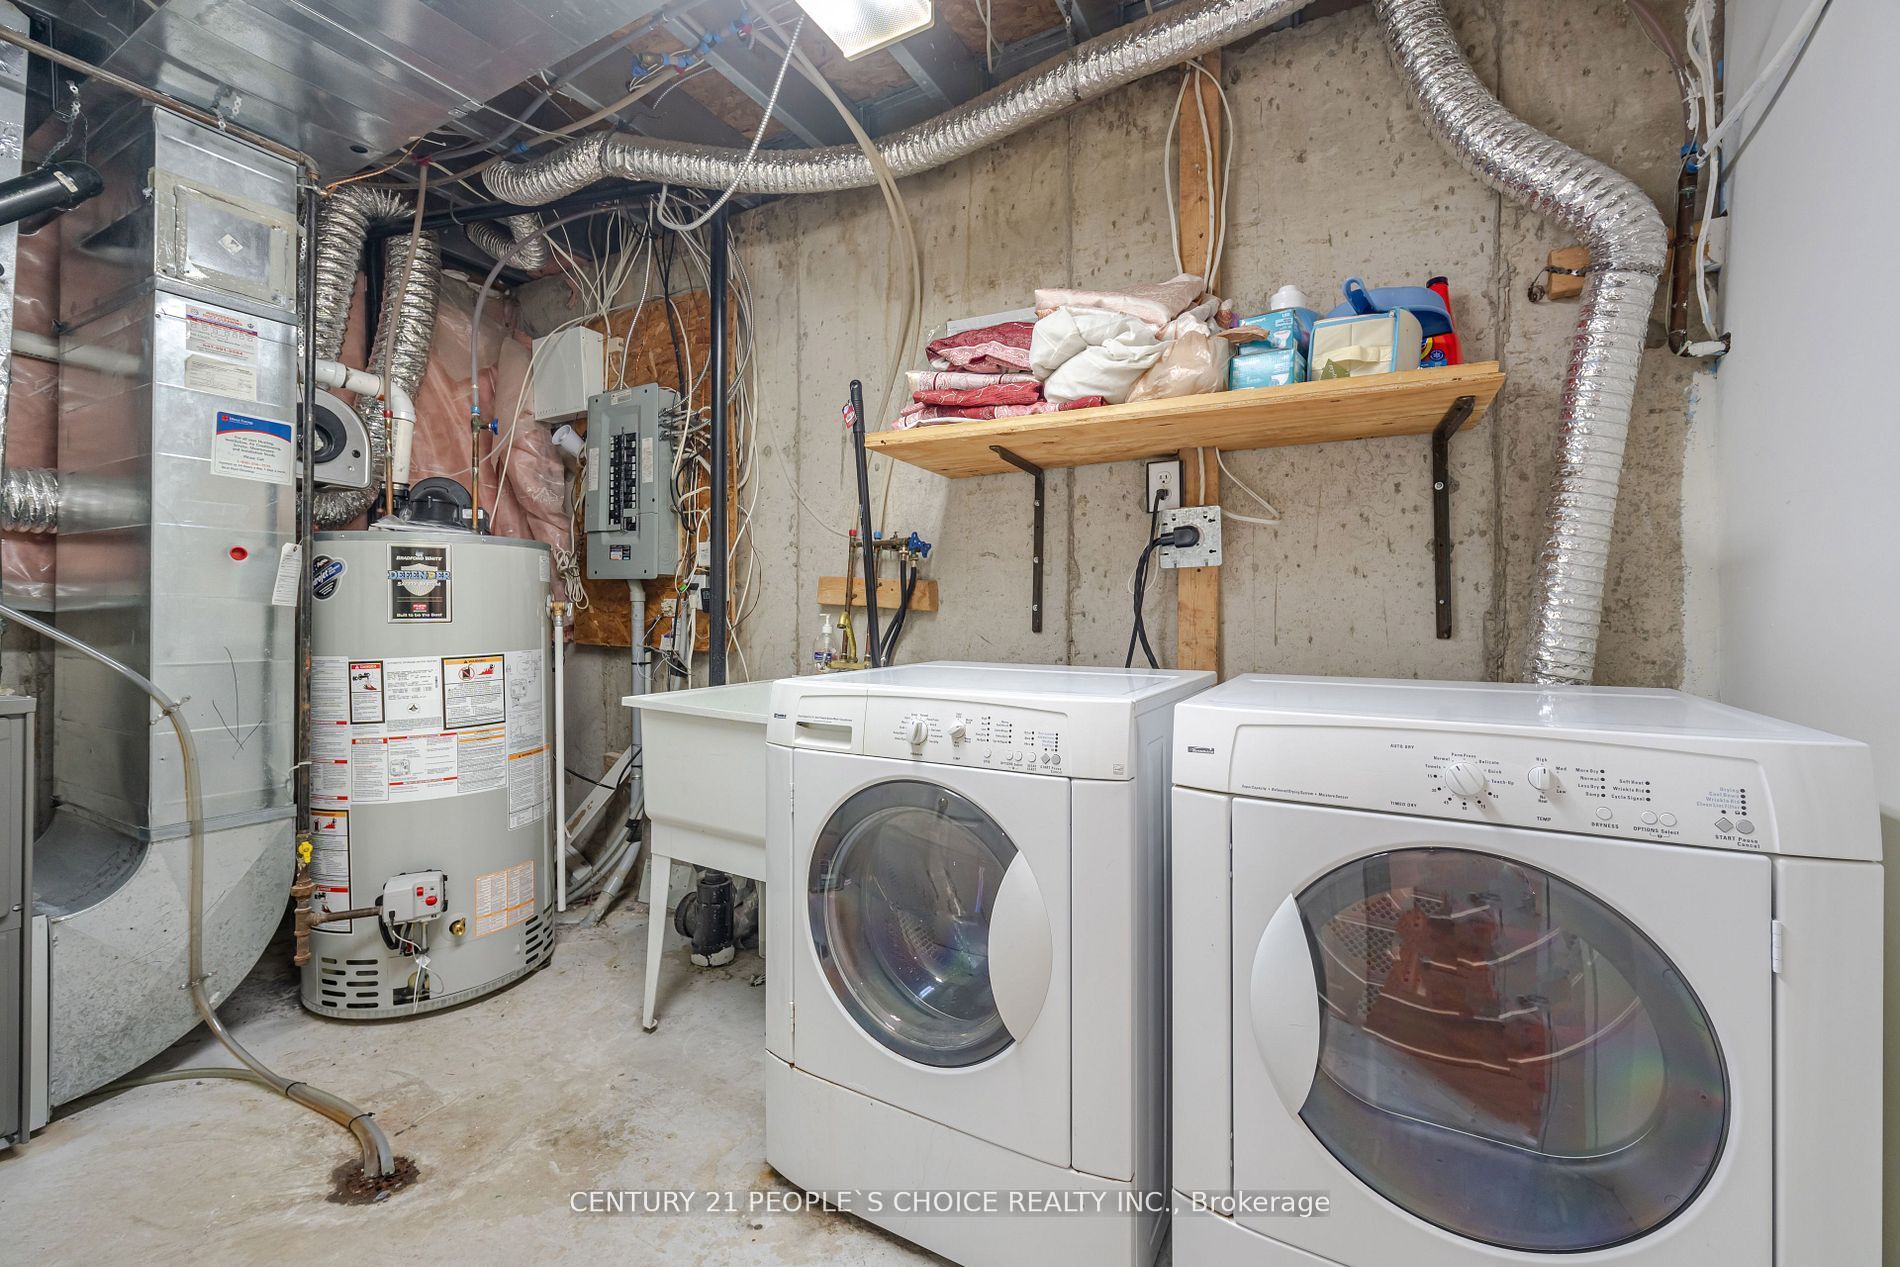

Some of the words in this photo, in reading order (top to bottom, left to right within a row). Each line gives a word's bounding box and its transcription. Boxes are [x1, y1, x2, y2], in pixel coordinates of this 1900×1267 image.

[388, 570, 450, 580] DEFENDER
[1591, 821, 1619, 830] DRYNESS
[1633, 826, 1659, 834] OPTIONS
[1660, 828, 1680, 836] Select
[1738, 836, 1759, 844] Pause
[1737, 841, 1761, 849] Cancel
